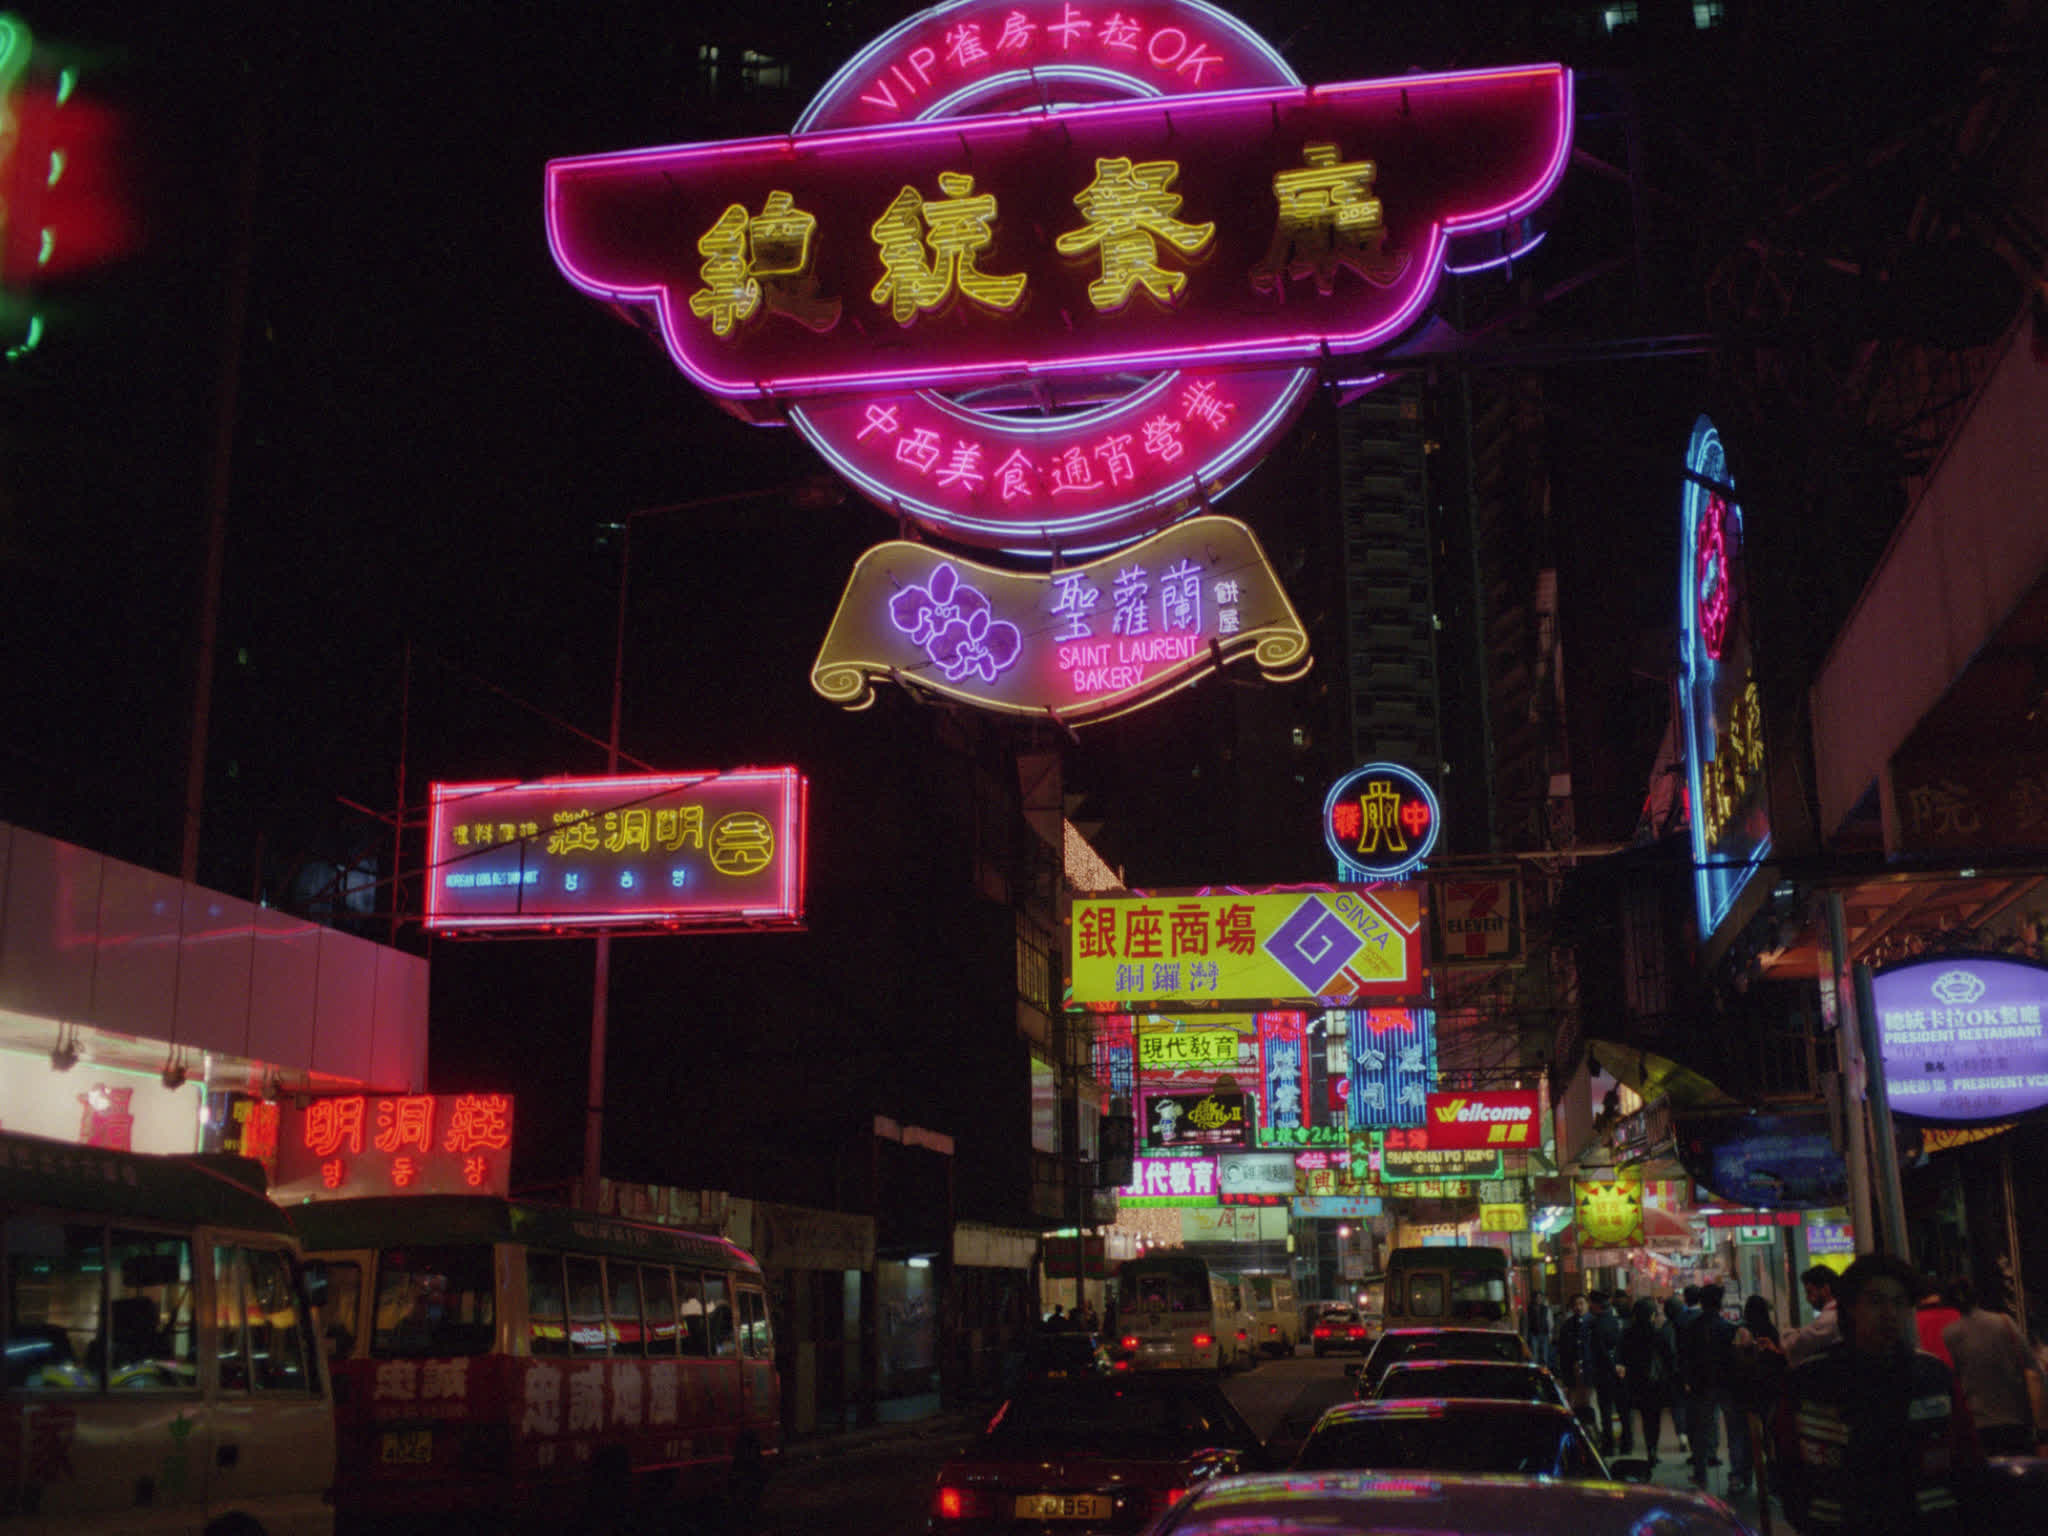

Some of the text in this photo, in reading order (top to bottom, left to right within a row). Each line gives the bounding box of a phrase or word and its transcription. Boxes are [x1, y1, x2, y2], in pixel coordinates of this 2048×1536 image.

[1058, 635, 1200, 670] SAINT LAURENT
[1073, 665, 1144, 692] BAKERY
[1335, 894, 1390, 952] GINZA
[1115, 961, 1220, 993] 銅鑼灣
[1143, 1035, 1235, 1059] 現代教育
[1884, 1024, 2043, 1045] PRESIDENT RESTAURANT
[1953, 1075, 2024, 1091] PRESIDENT
[1434, 1098, 1532, 1123] Wellcome
[304, 1095, 508, 1157] 明洞莊
